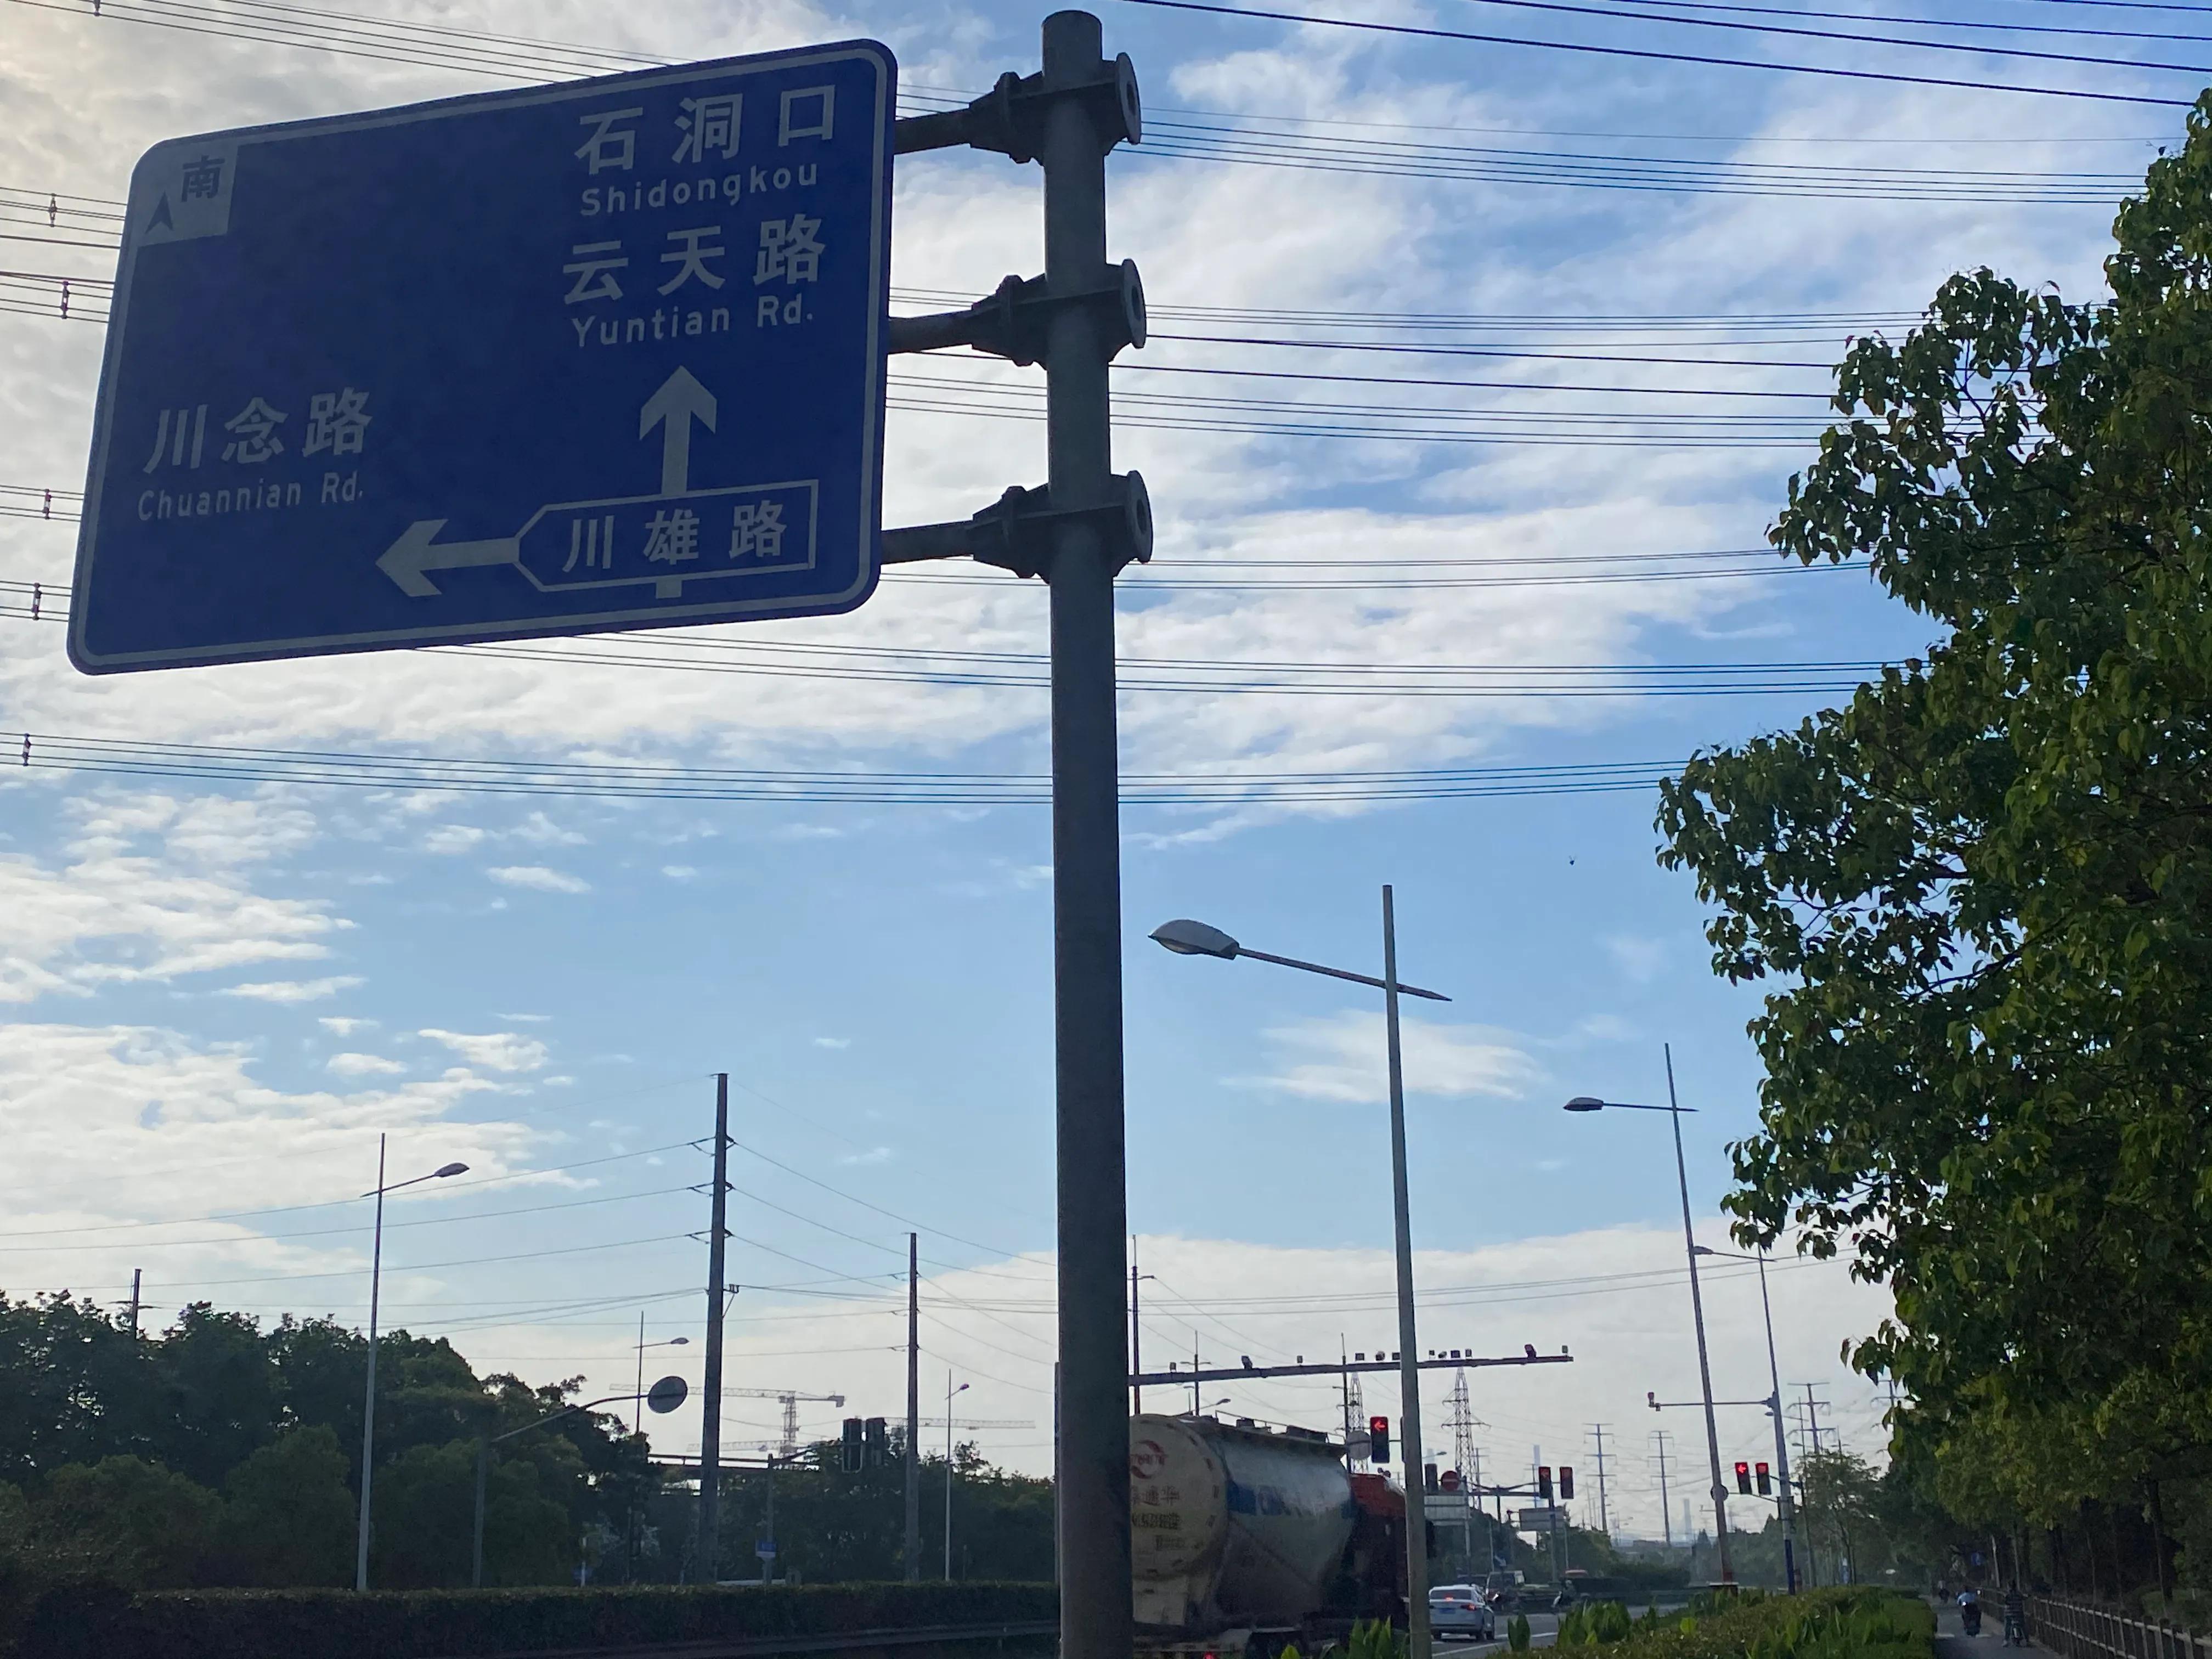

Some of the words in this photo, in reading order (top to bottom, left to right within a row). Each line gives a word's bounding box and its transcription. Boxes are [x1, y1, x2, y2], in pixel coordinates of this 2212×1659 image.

[574, 84, 836, 176] 石洞口
[181, 155, 225, 202] 南
[580, 163, 817, 216] Shidongkou
[562, 213, 826, 305] 云天路
[571, 307, 730, 347] Yuntian
[757, 293, 813, 328] Rd.
[143, 387, 373, 475] 川念路
[138, 477, 301, 521] Chuannian
[321, 470, 363, 504] Rd.
[562, 500, 787, 573] 川雄路
